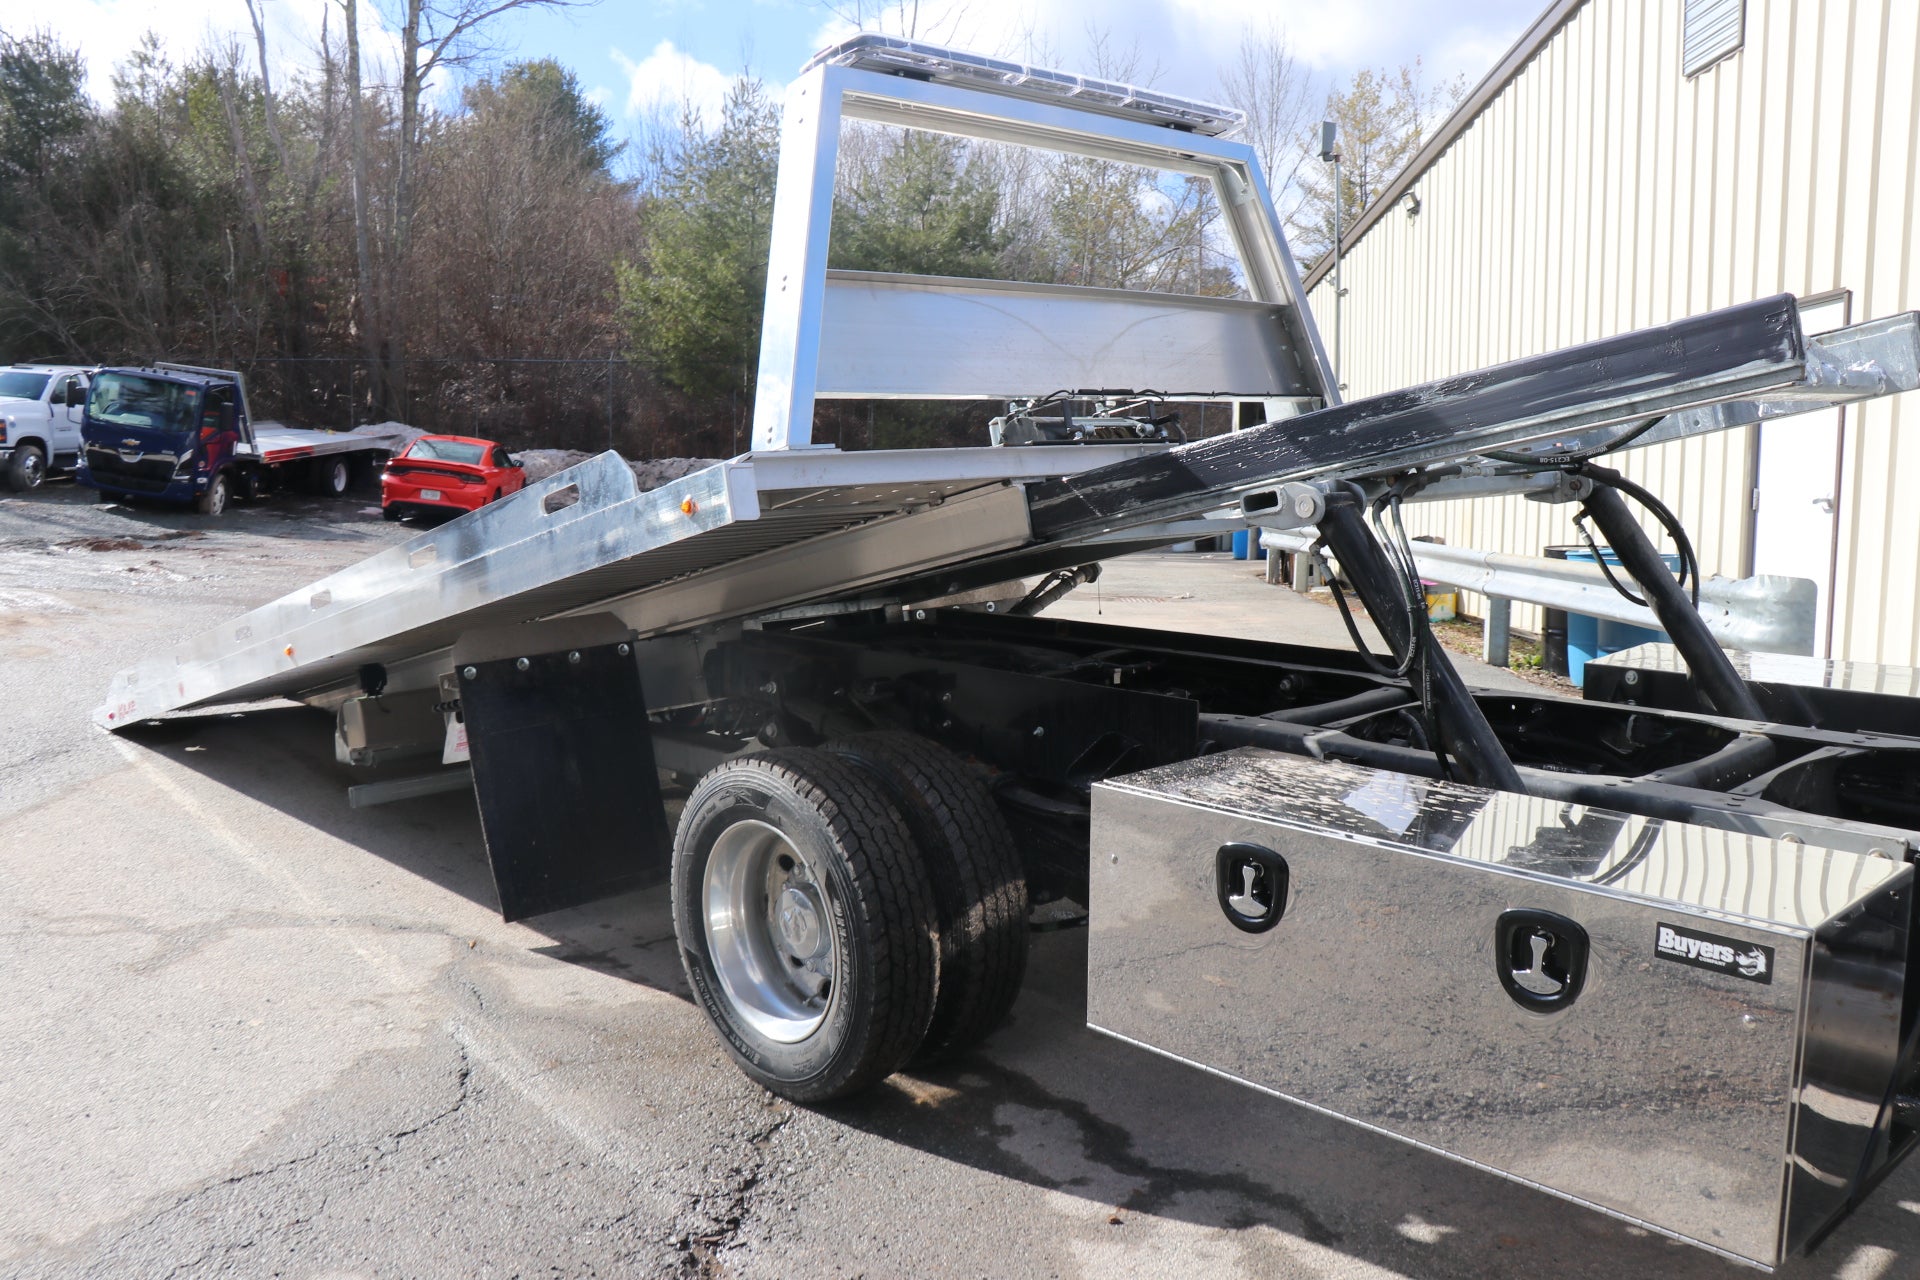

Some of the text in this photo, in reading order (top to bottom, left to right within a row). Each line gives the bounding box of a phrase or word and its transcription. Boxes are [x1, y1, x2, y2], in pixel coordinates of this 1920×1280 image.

[1657, 945, 1727, 967] PRODUCTS COMPANY
[1658, 926, 1735, 963] Buyers
